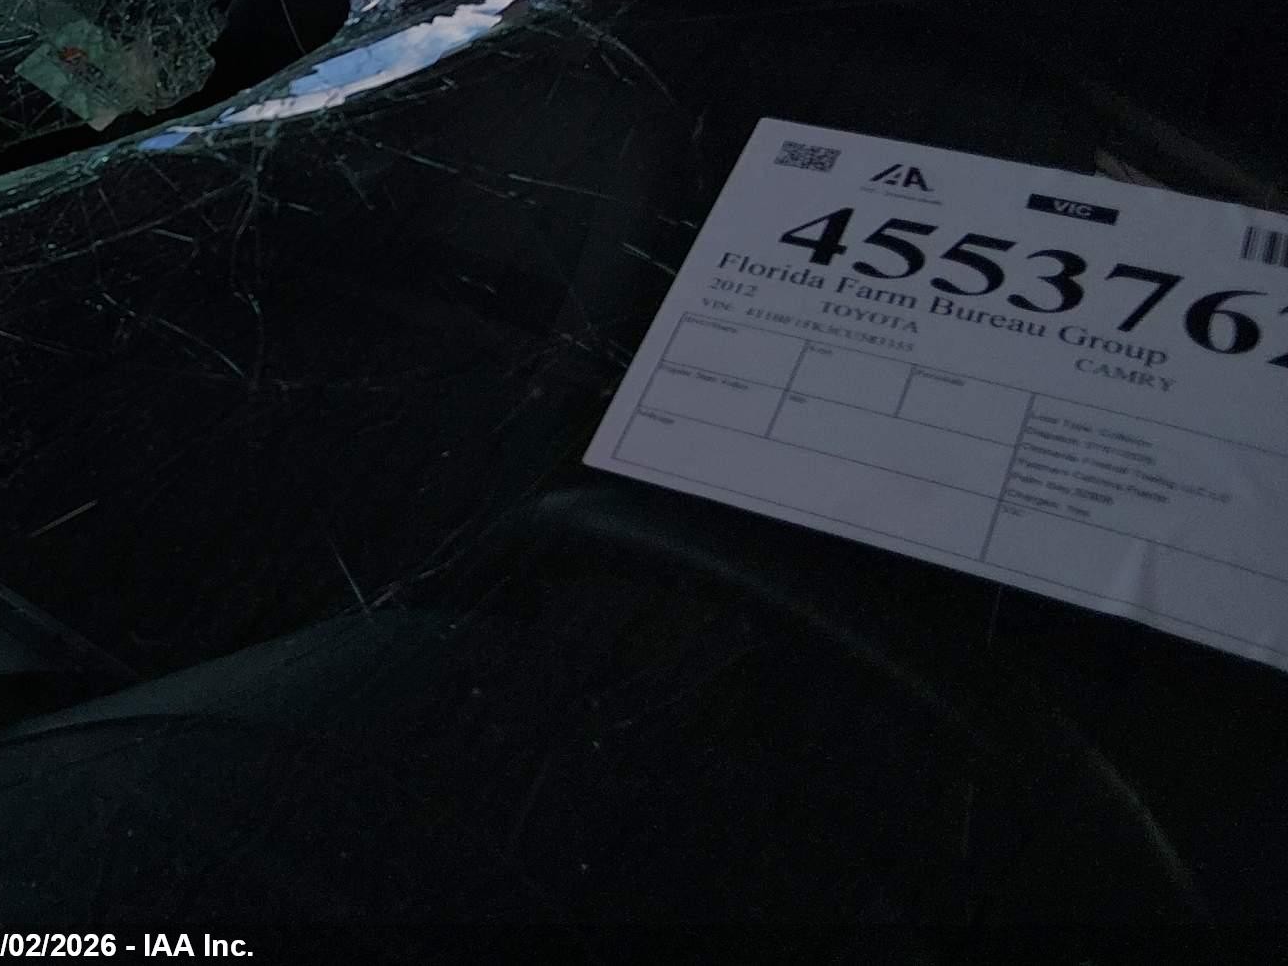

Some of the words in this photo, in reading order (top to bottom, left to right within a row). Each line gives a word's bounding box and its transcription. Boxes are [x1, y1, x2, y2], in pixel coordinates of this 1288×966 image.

[709, 276, 760, 297] 2012
[820, 300, 918, 334] TOYOTA
[1073, 357, 1177, 393] CAMRY
[717, 252, 825, 290] Florida
[836, 276, 918, 310] Farm
[929, 295, 1047, 338] Bureau
[1058, 325, 1168, 368] Group
[778, 206, 1288, 369] 455376
